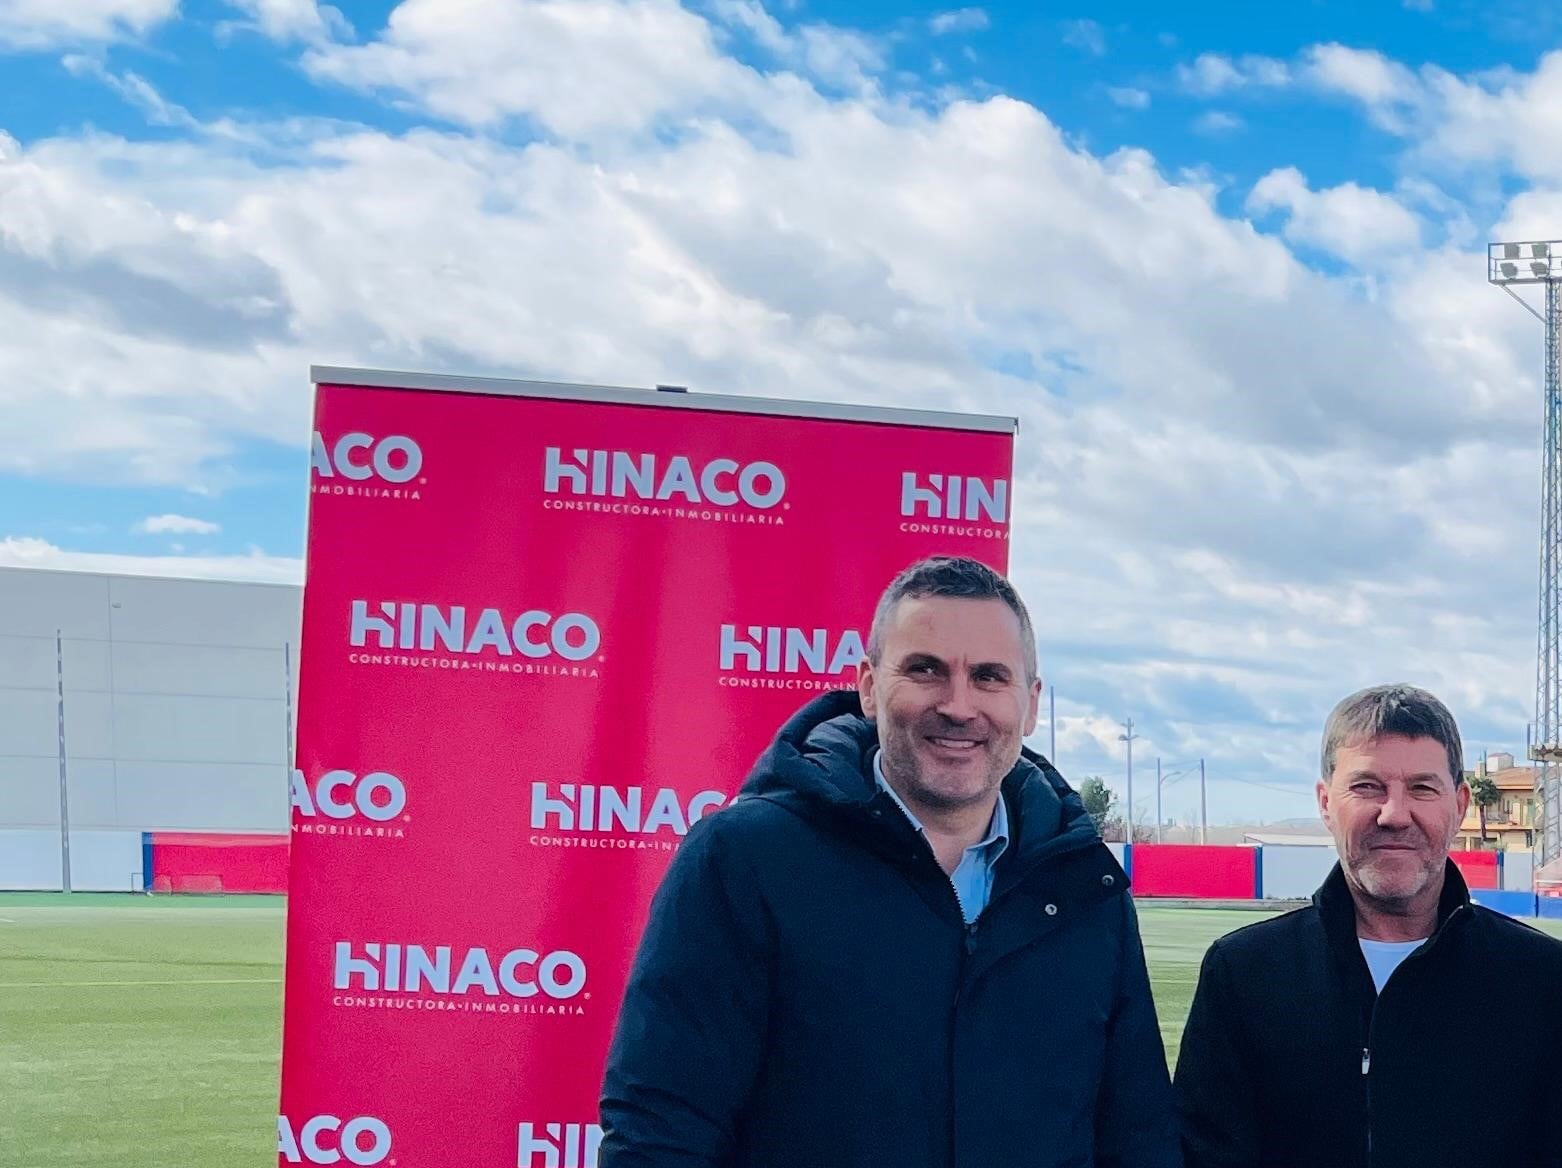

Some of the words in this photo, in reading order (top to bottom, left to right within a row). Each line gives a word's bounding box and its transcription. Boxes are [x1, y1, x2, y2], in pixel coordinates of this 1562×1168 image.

[543, 446, 786, 509] HINACO
[350, 599, 600, 661] HINACO
[334, 940, 587, 1000] HINACO
